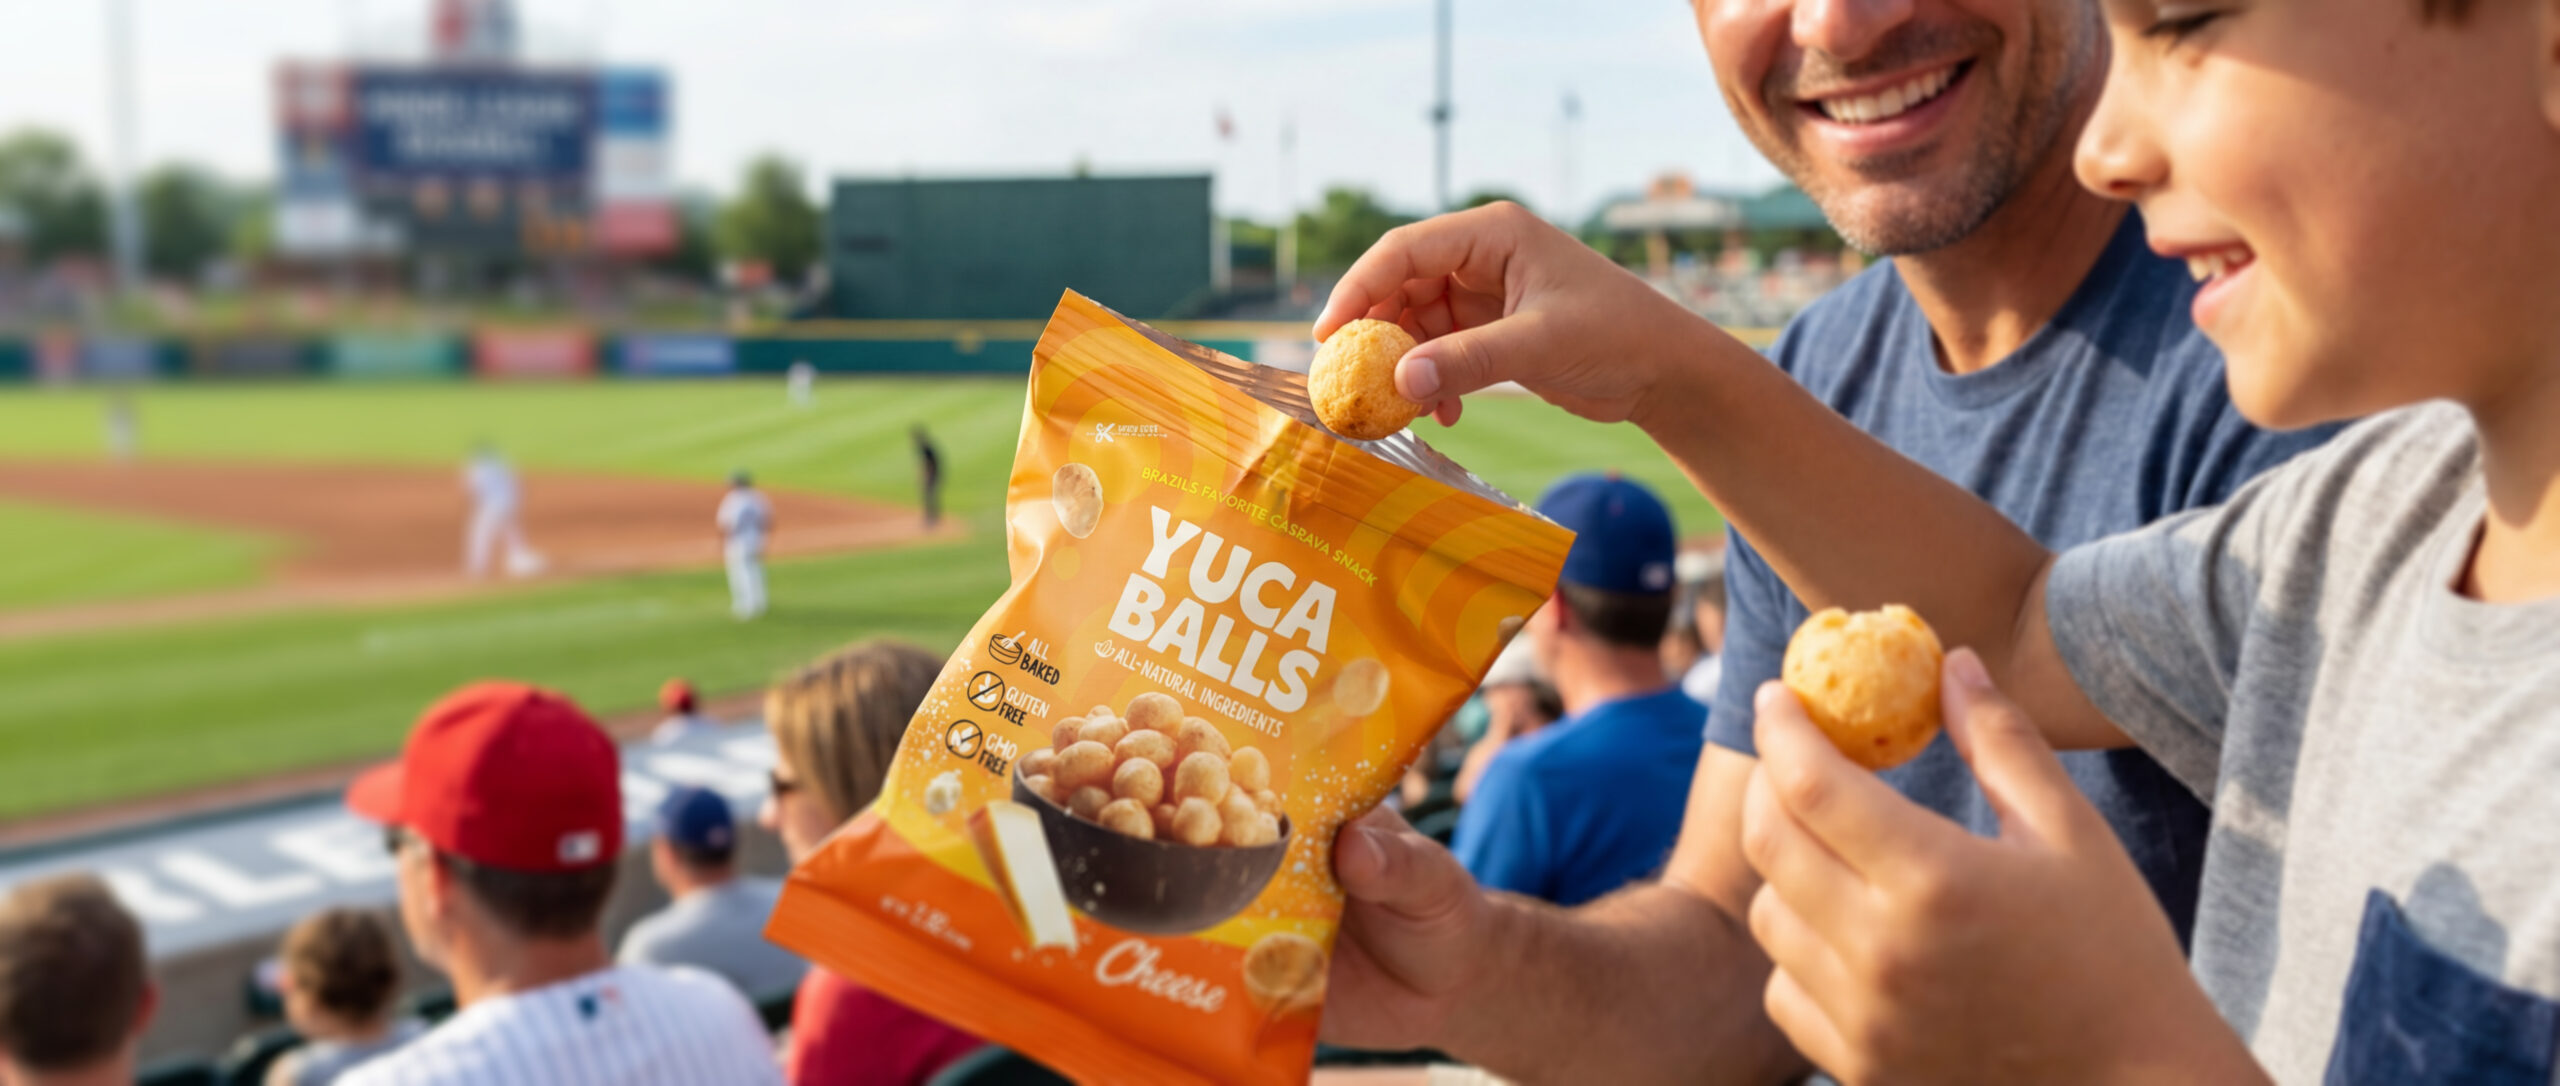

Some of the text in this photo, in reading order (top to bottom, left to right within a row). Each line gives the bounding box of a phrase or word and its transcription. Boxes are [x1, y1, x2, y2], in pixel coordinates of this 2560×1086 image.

[1142, 467, 1199, 495] BRAZILS
[1201, 485, 1268, 521] FAVORITE
[1332, 549, 1378, 588] SNACK
[1141, 504, 1337, 655] YUCA
[1019, 653, 1060, 686] BAKED
[1027, 638, 1050, 661] ALL
[1107, 572, 1321, 714] BALLS
[998, 702, 1028, 727] FREE
[1113, 648, 1285, 739] ALL-NATURAL INGREDIENTS
[977, 749, 1008, 777] FREE
[1095, 938, 1227, 1014] Cheese
